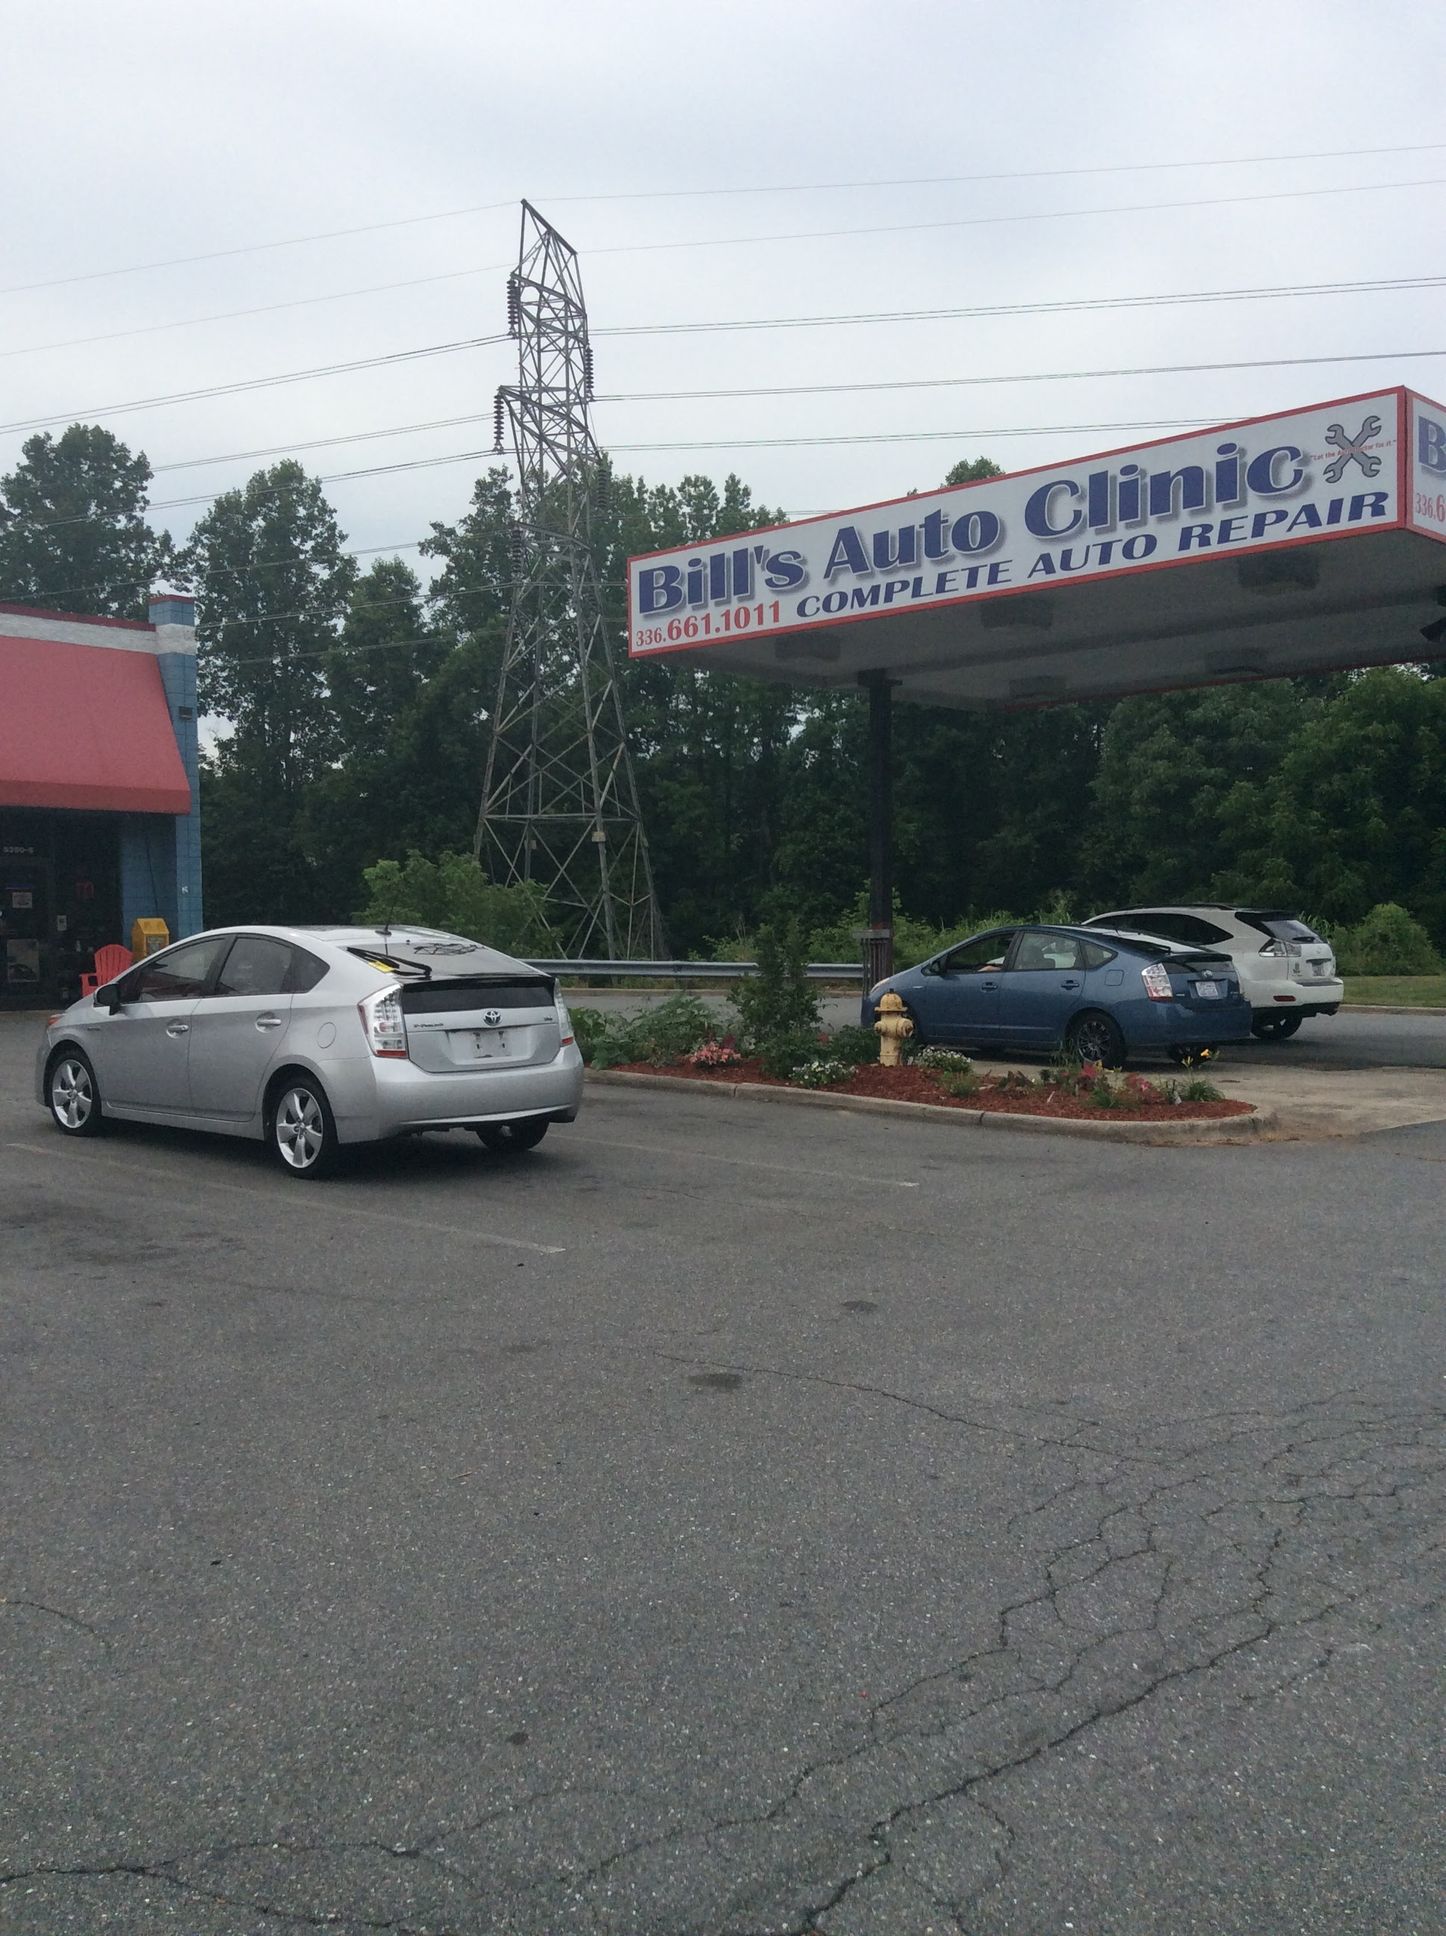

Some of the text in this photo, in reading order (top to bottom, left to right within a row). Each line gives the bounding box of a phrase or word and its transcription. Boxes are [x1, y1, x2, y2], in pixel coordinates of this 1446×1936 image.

[638, 441, 1304, 615] Bill's Auto Clinic
[796, 490, 1390, 618] COMPLETE AUTO REPAIR
[636, 600, 781, 647] 336.661.1011
